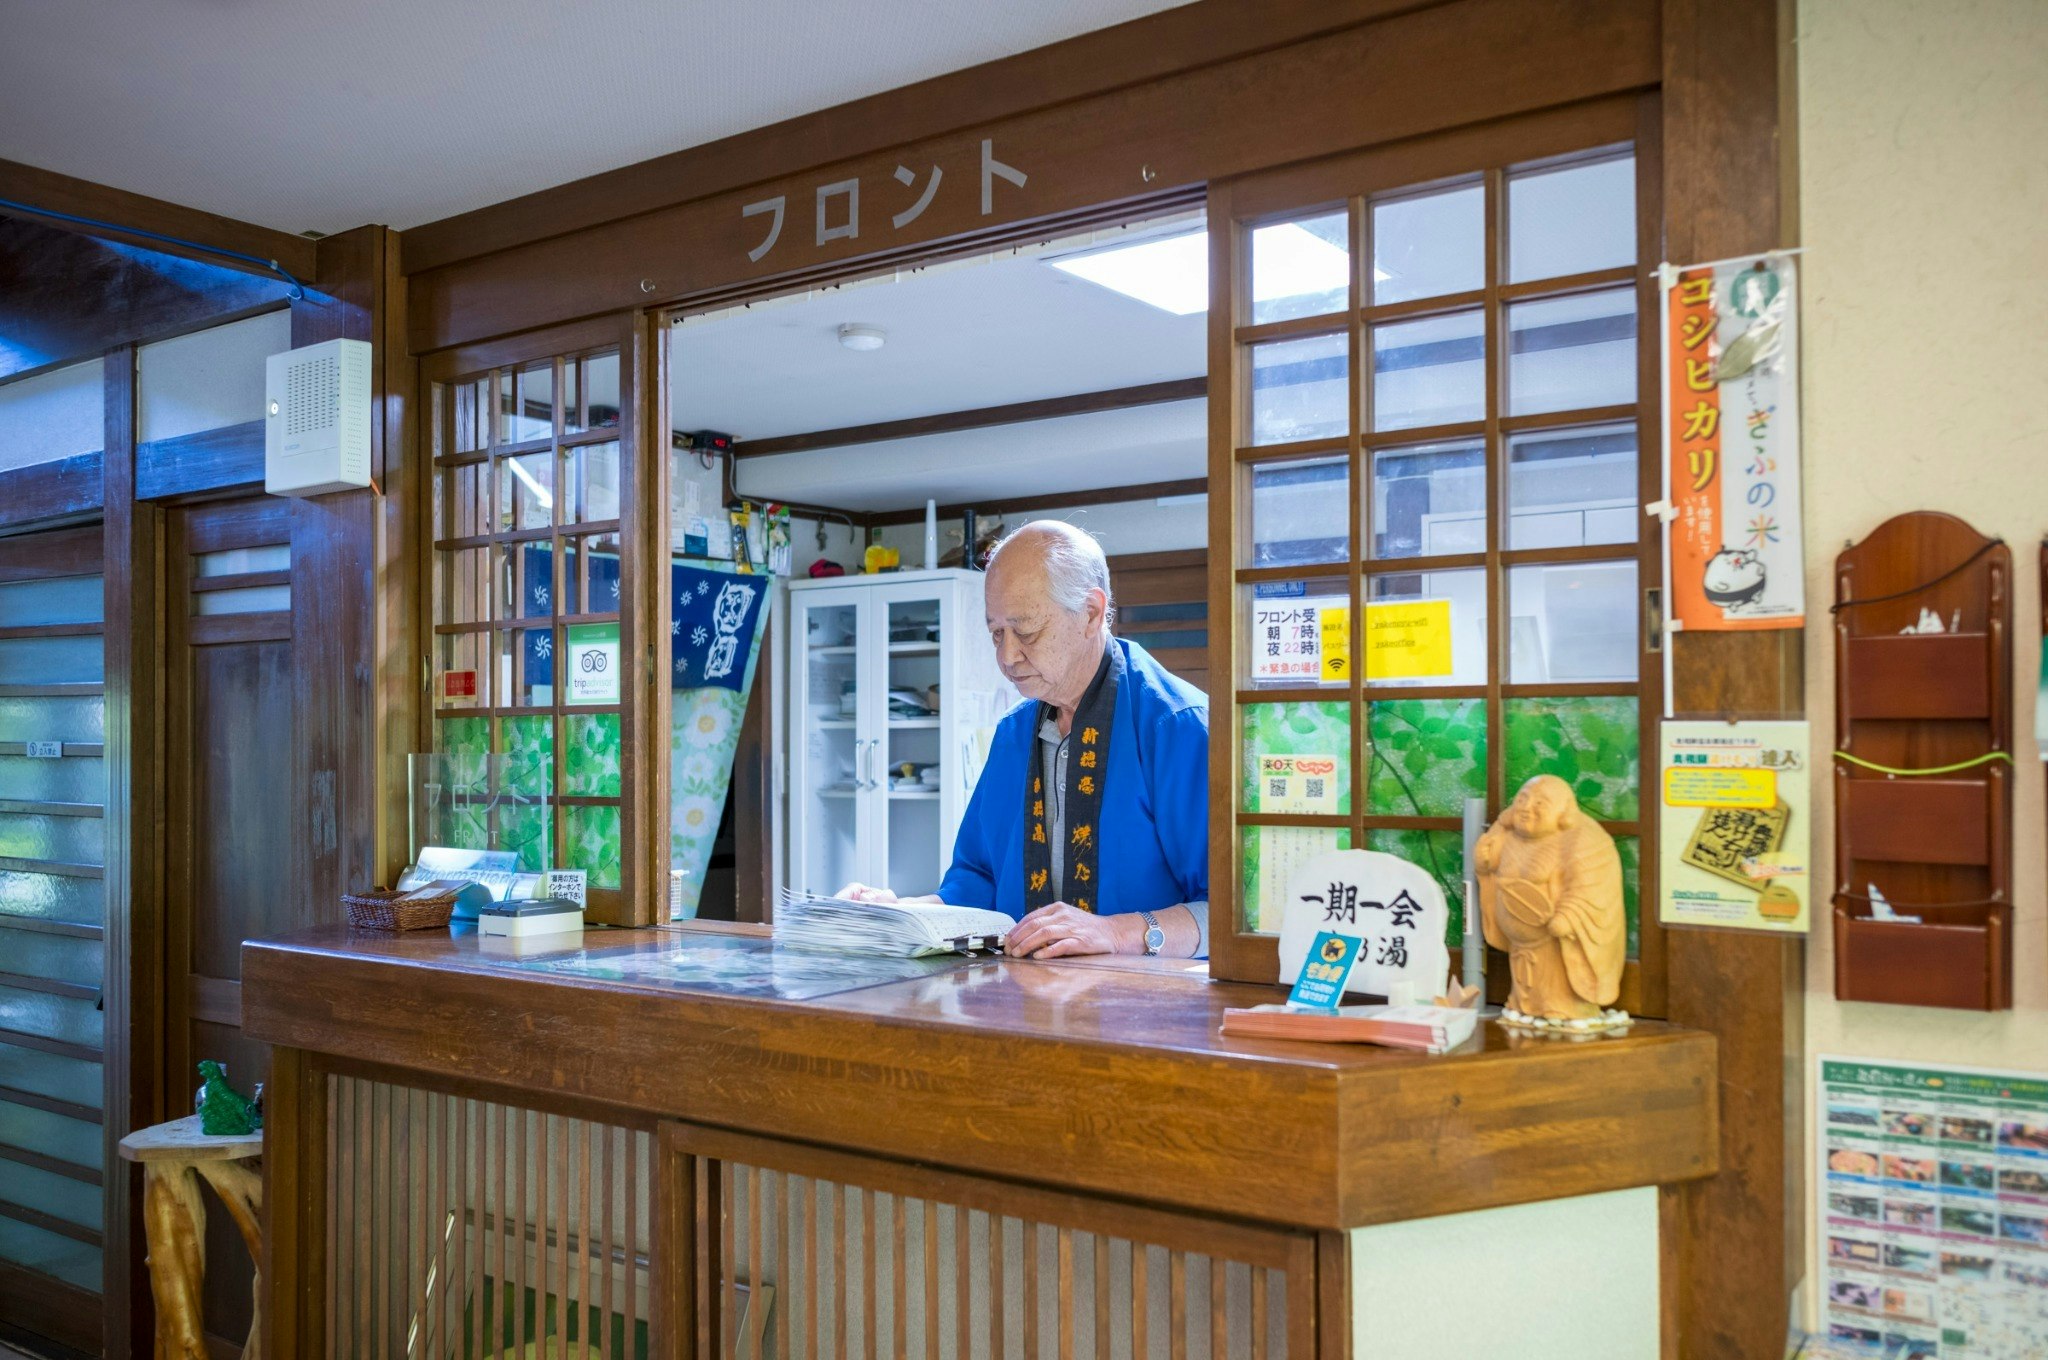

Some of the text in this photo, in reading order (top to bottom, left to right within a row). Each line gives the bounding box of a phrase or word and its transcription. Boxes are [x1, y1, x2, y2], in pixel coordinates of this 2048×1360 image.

[742, 138, 1028, 263] フロント
[1681, 278, 1720, 491] コシヒカリ
[1745, 405, 1779, 548] ぎふの米
[1257, 608, 1315, 624] フロント受
[1267, 626, 1280, 640] 朝
[1267, 642, 1280, 656] 夜
[574, 677, 613, 690] tripadvisor
[424, 783, 530, 816] フロント
[454, 829, 498, 844] FRT
[1300, 881, 1423, 929] 一期一会
